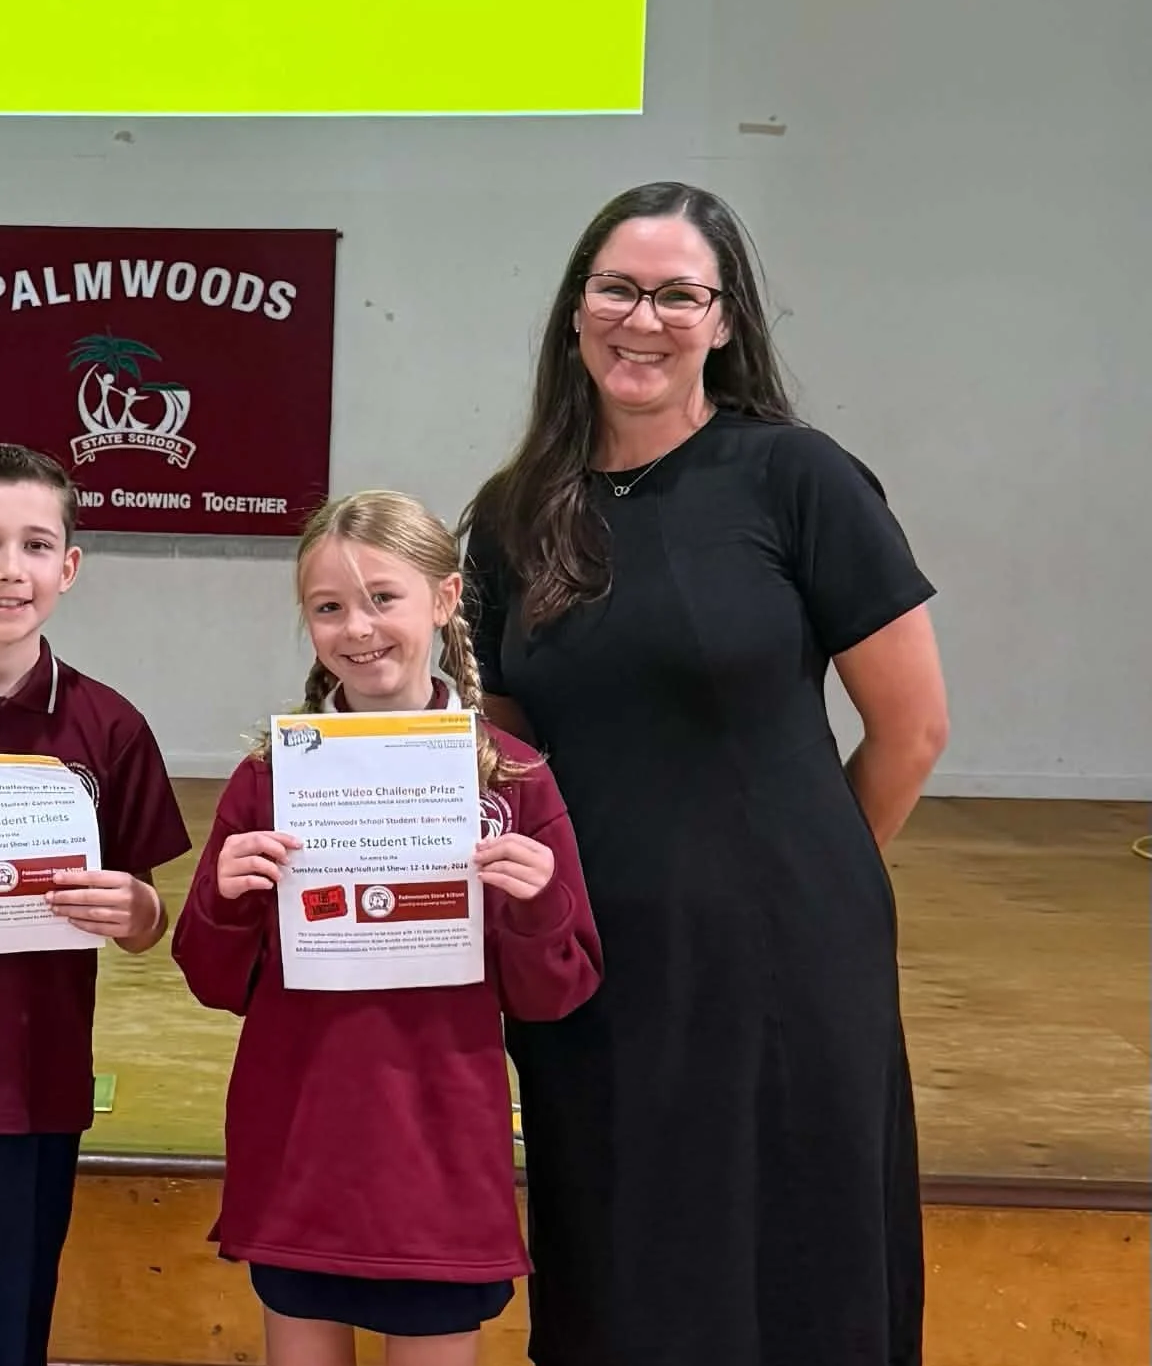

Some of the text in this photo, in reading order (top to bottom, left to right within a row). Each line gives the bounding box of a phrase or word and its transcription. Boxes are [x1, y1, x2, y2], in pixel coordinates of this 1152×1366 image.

[81, 433, 184, 454] STATE SCHOOL
[111, 488, 191, 509] GROWING
[202, 492, 288, 514] TOGETHER
[298, 785, 456, 800] Student Video Challenge Prize
[29, 814, 70, 824] Tickets
[305, 835, 452, 849] 120 Free Student Tickets
